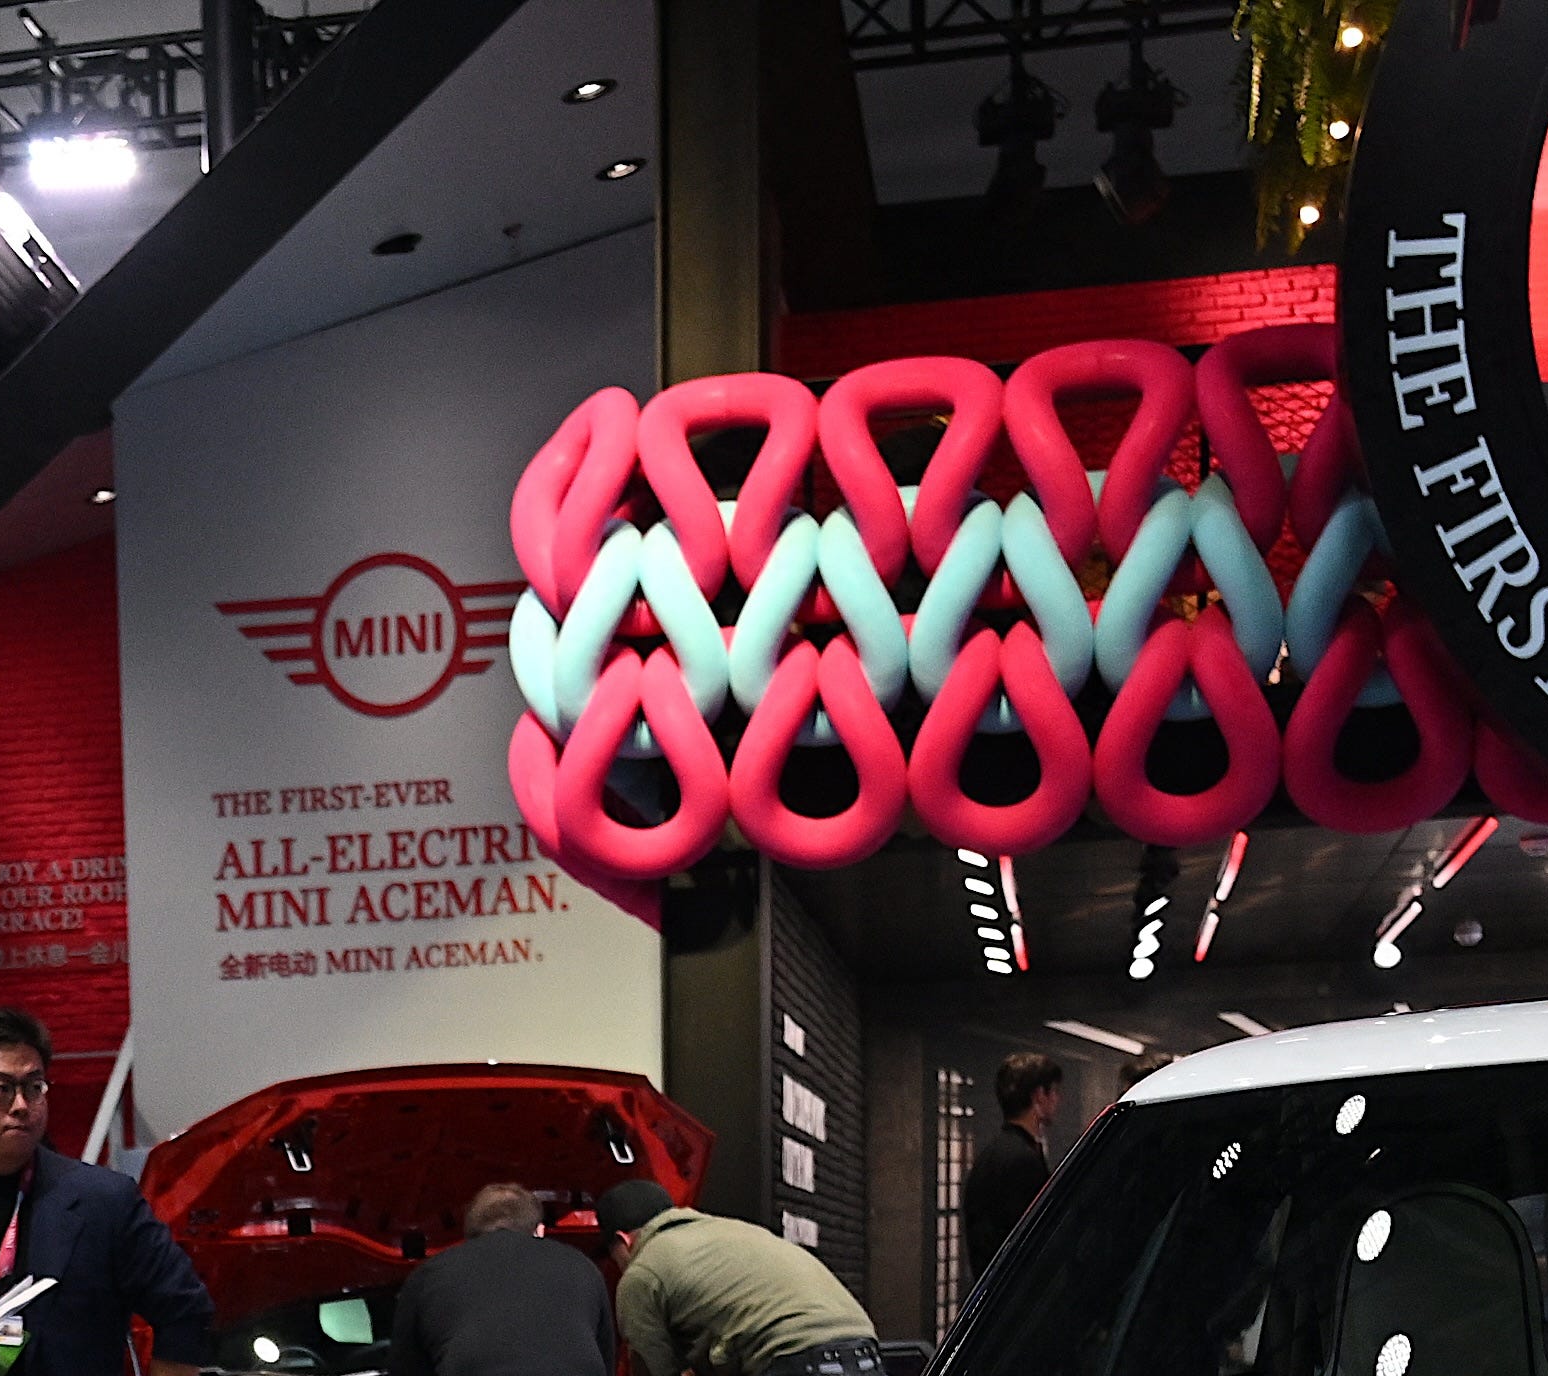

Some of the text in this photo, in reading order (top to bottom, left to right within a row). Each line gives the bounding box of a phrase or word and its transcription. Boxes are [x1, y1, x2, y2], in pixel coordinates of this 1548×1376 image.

[1385, 211, 1480, 431] THE
[334, 611, 443, 659] MINI
[212, 778, 454, 818] THE FIRST-EVER
[214, 872, 570, 933] MINI ACEMAN.
[218, 950, 318, 981] 全新电动
[325, 946, 395, 976] MINI
